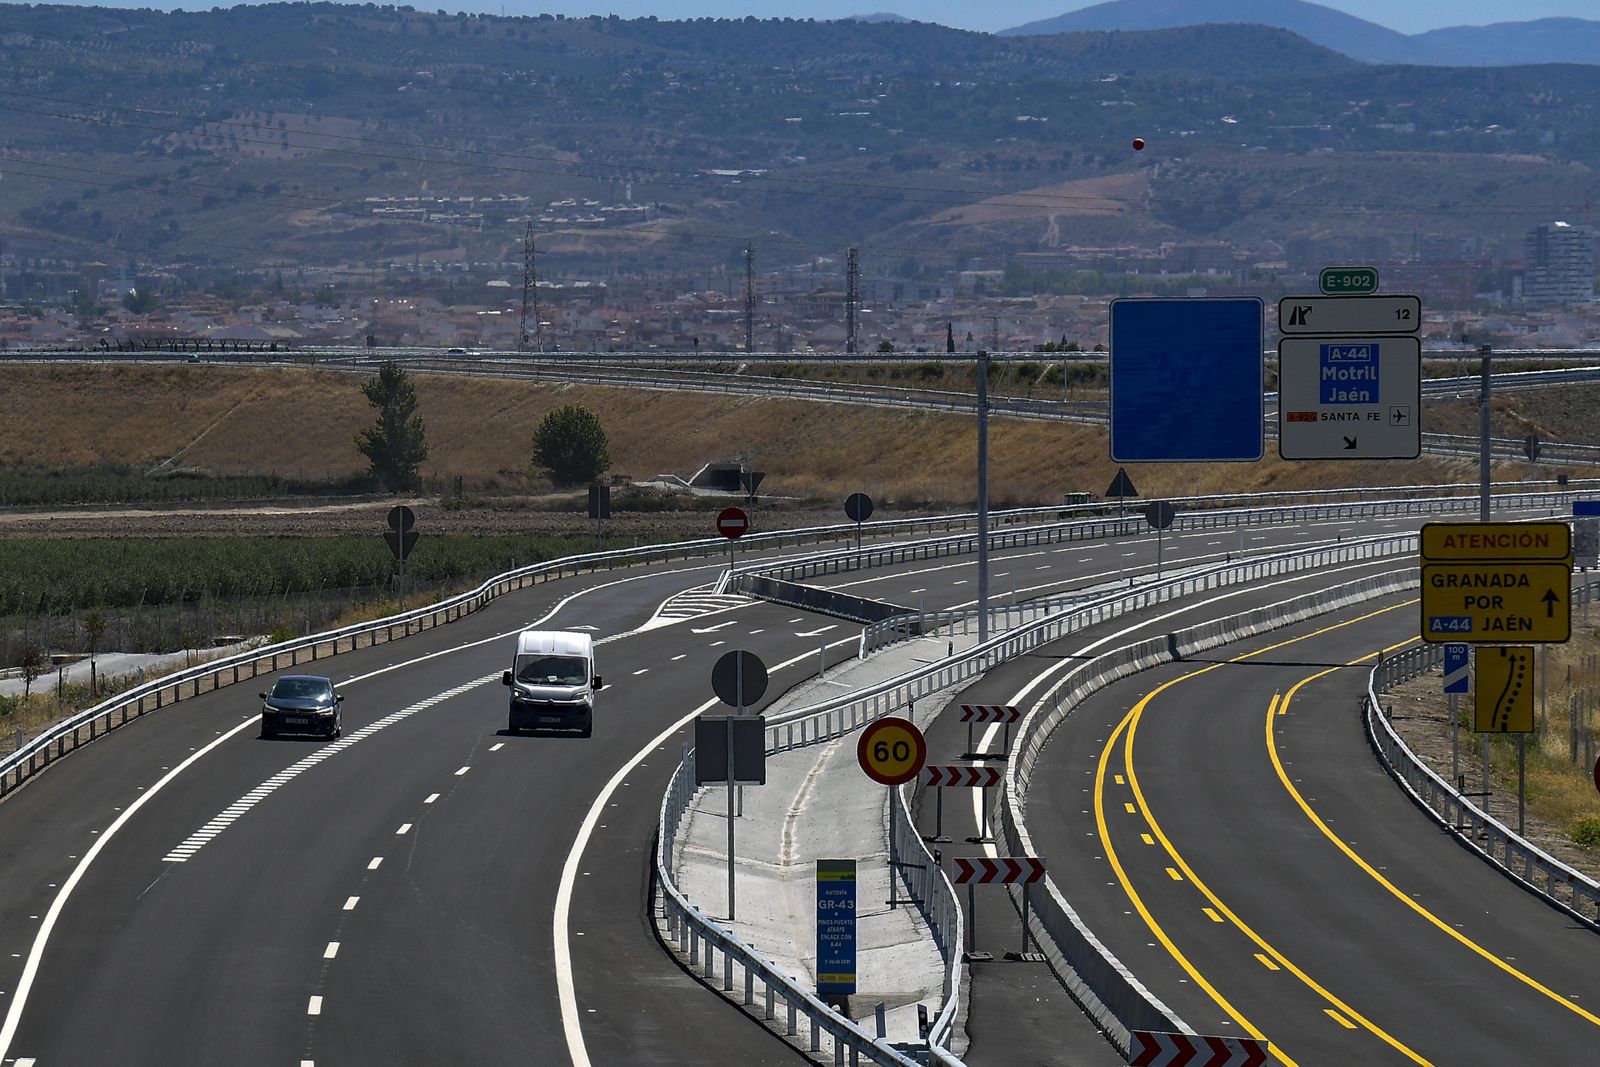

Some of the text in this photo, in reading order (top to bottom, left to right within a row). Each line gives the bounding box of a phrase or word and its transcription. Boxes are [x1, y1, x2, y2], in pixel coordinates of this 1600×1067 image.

[1327, 275, 1371, 287] E-902
[1395, 308, 1411, 320] 12
[1331, 347, 1368, 360] A-44
[1322, 365, 1377, 381] Motril
[1329, 387, 1370, 402] Jaén
[1321, 412, 1360, 421] SANTA
[1367, 412, 1381, 421] FE
[1443, 530, 1549, 549] ATENCIÓN
[1431, 573, 1530, 588] GRANADA
[1464, 595, 1504, 610] POR
[1431, 614, 1533, 632] A-44 JAÉN
[1448, 646, 1465, 654] 100
[873, 740, 911, 763] 60
[818, 900, 854, 910] GR-43
